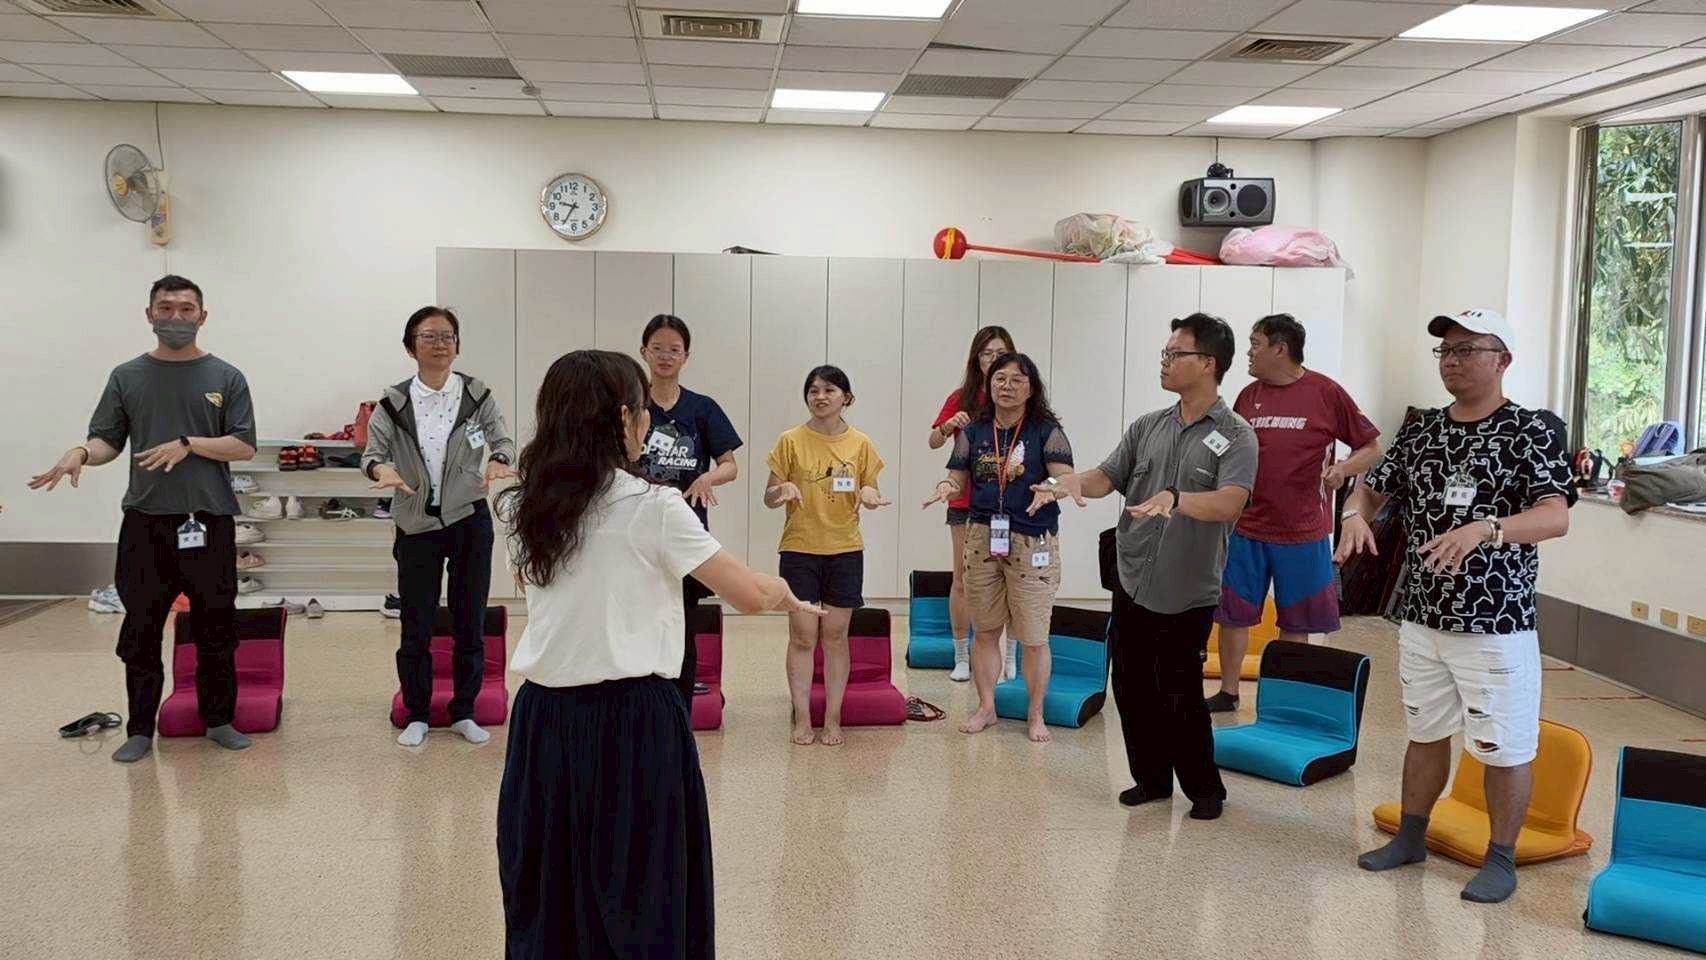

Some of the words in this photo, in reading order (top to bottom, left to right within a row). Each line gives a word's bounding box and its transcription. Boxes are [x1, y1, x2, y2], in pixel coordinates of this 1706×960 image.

[560, 184, 568, 193] 11
[569, 182, 578, 191] 12
[553, 192, 562, 201] 10
[589, 193, 595, 201] 2
[549, 201, 556, 210] 9
[592, 202, 598, 211] 3
[553, 212, 559, 221] 8
[588, 213, 595, 221] 4
[571, 222, 578, 231] 6
[582, 220, 588, 229] 5
[657, 456, 698, 468] RACING
